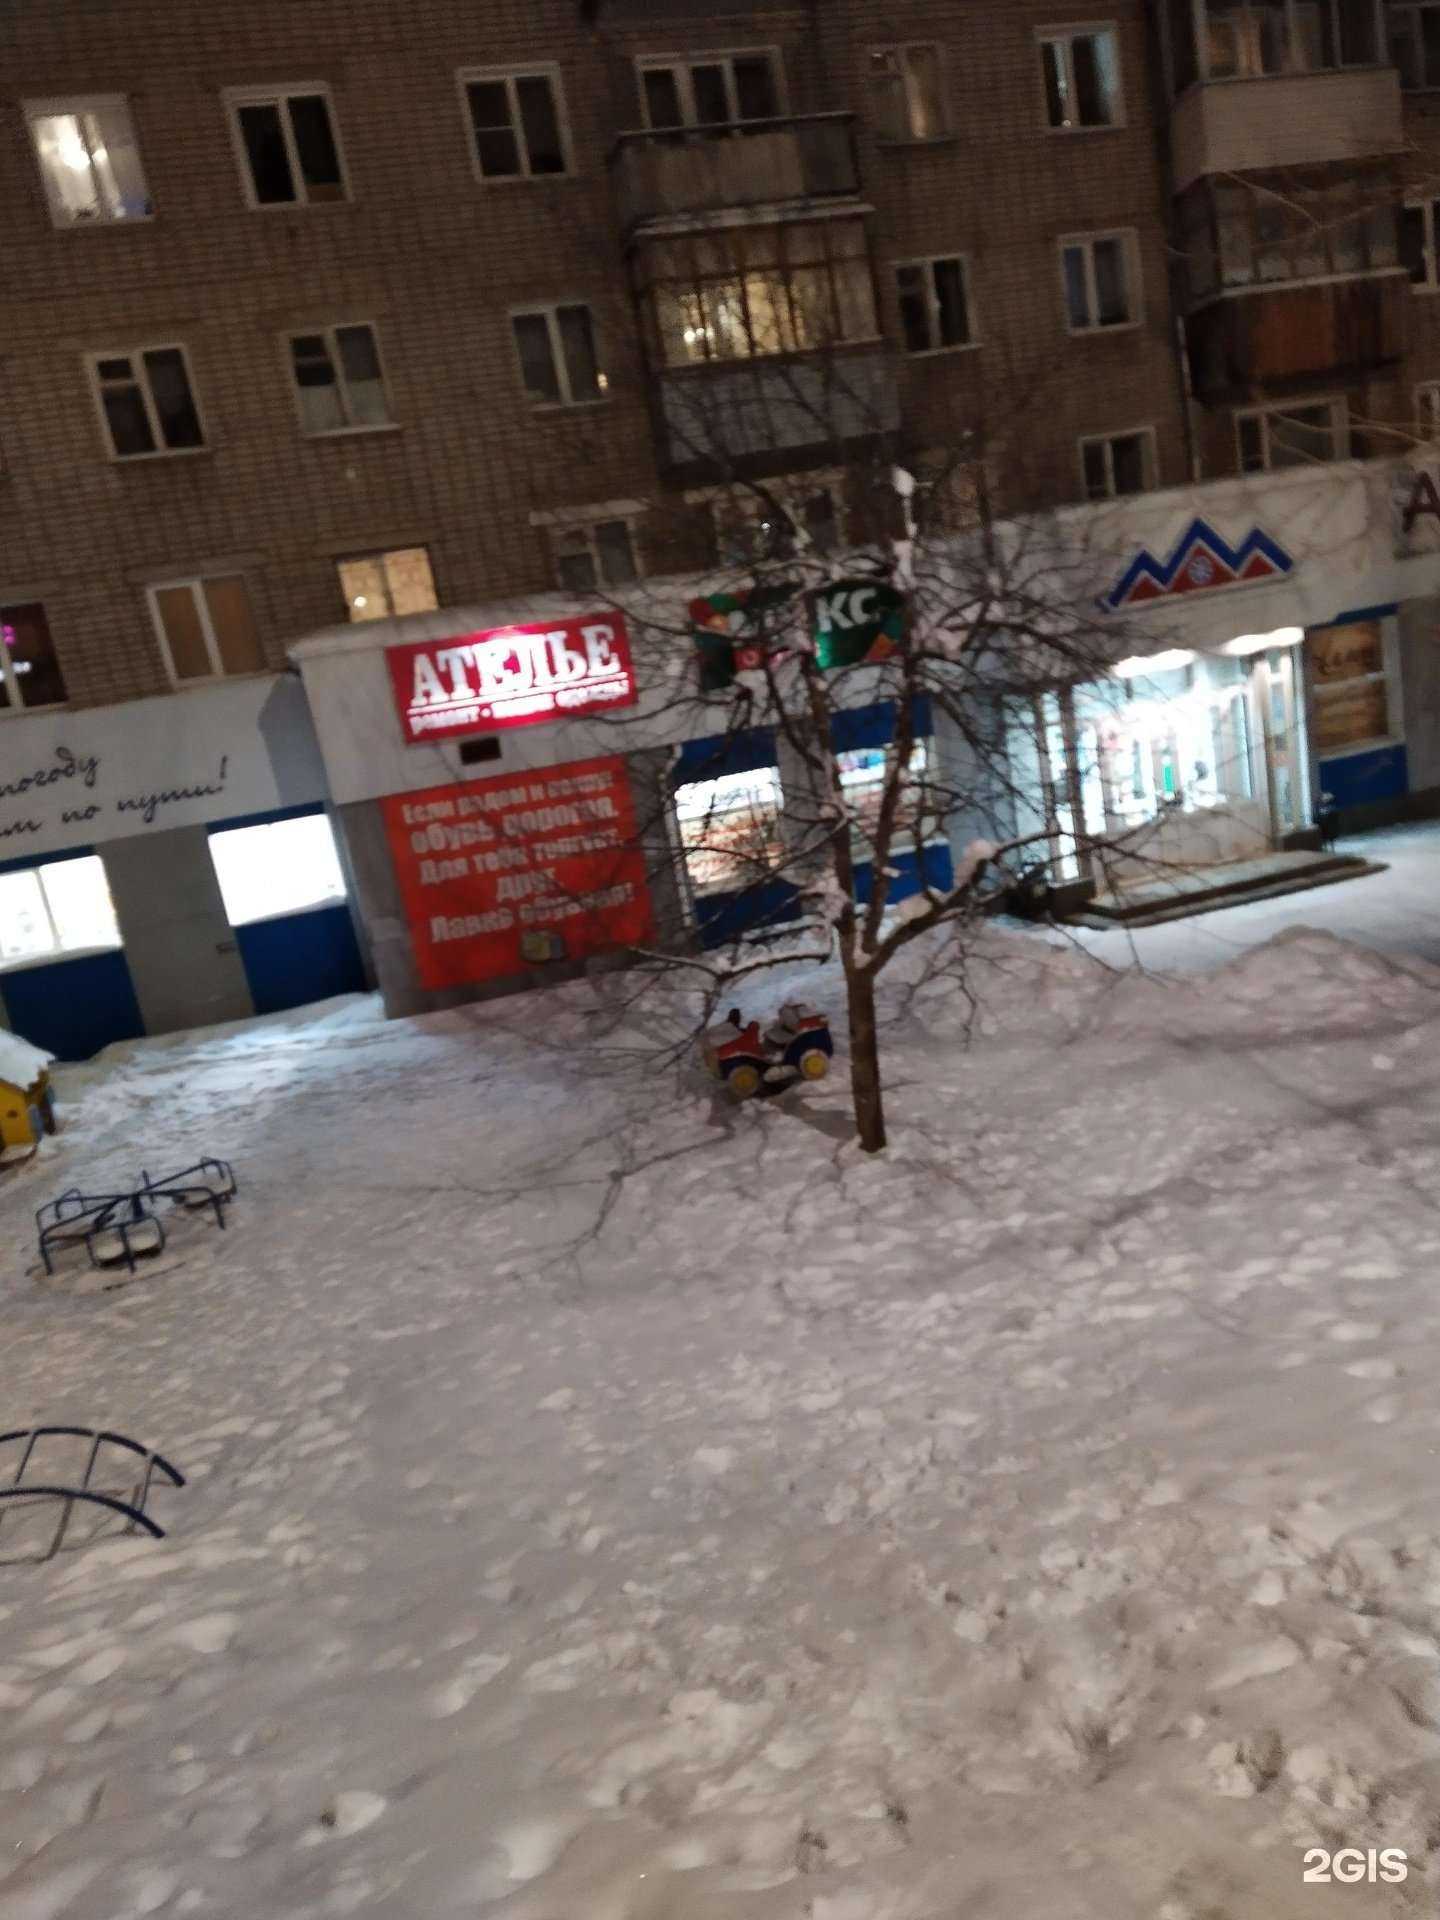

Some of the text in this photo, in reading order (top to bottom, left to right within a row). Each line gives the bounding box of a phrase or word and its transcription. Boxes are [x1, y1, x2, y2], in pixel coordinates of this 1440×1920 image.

[411, 624, 622, 707] АТЕЛЬЕ
[117, 755, 228, 823] пути!
[402, 801, 455, 824] Если
[419, 857, 469, 885] Для
